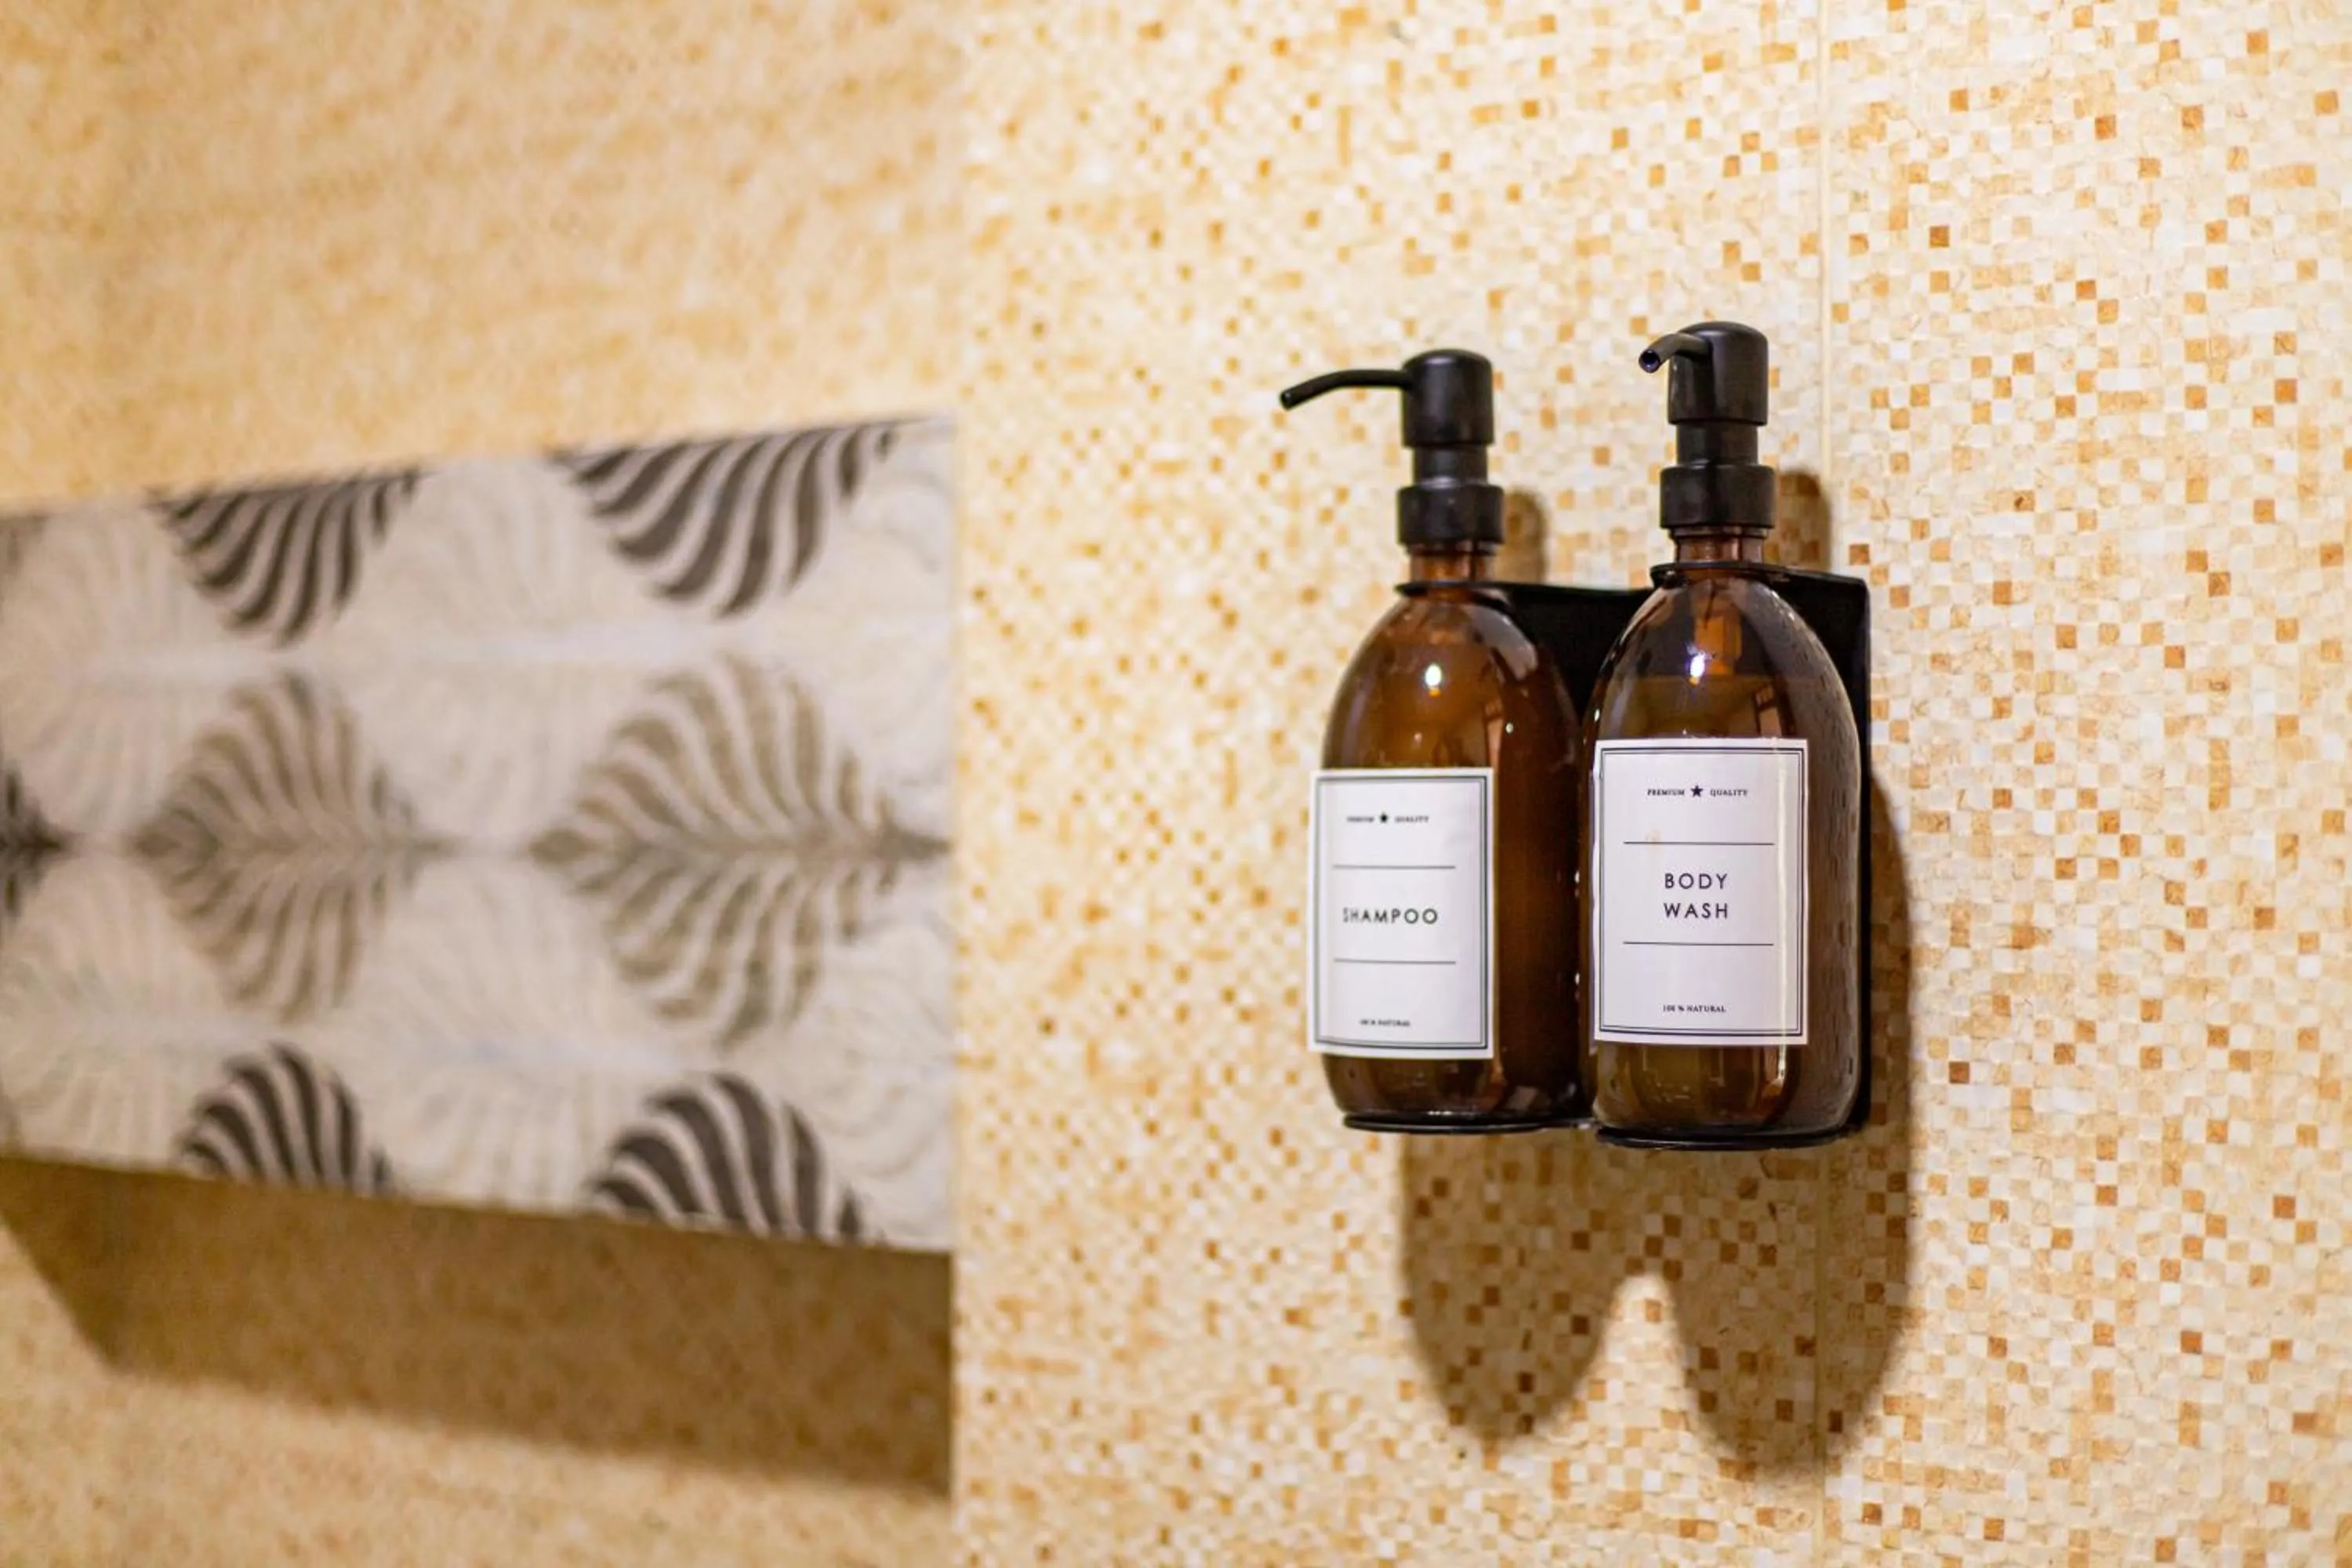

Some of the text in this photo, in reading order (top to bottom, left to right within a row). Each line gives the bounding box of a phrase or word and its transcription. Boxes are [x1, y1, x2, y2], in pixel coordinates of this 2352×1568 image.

[1646, 788, 1748, 797] PREMIUM QUALITY
[1664, 872, 1728, 890] BODY
[1342, 906, 1439, 925] SHAMPOO
[1663, 902, 1729, 920] WASH
[1686, 1004, 1726, 1013] NATURAL
